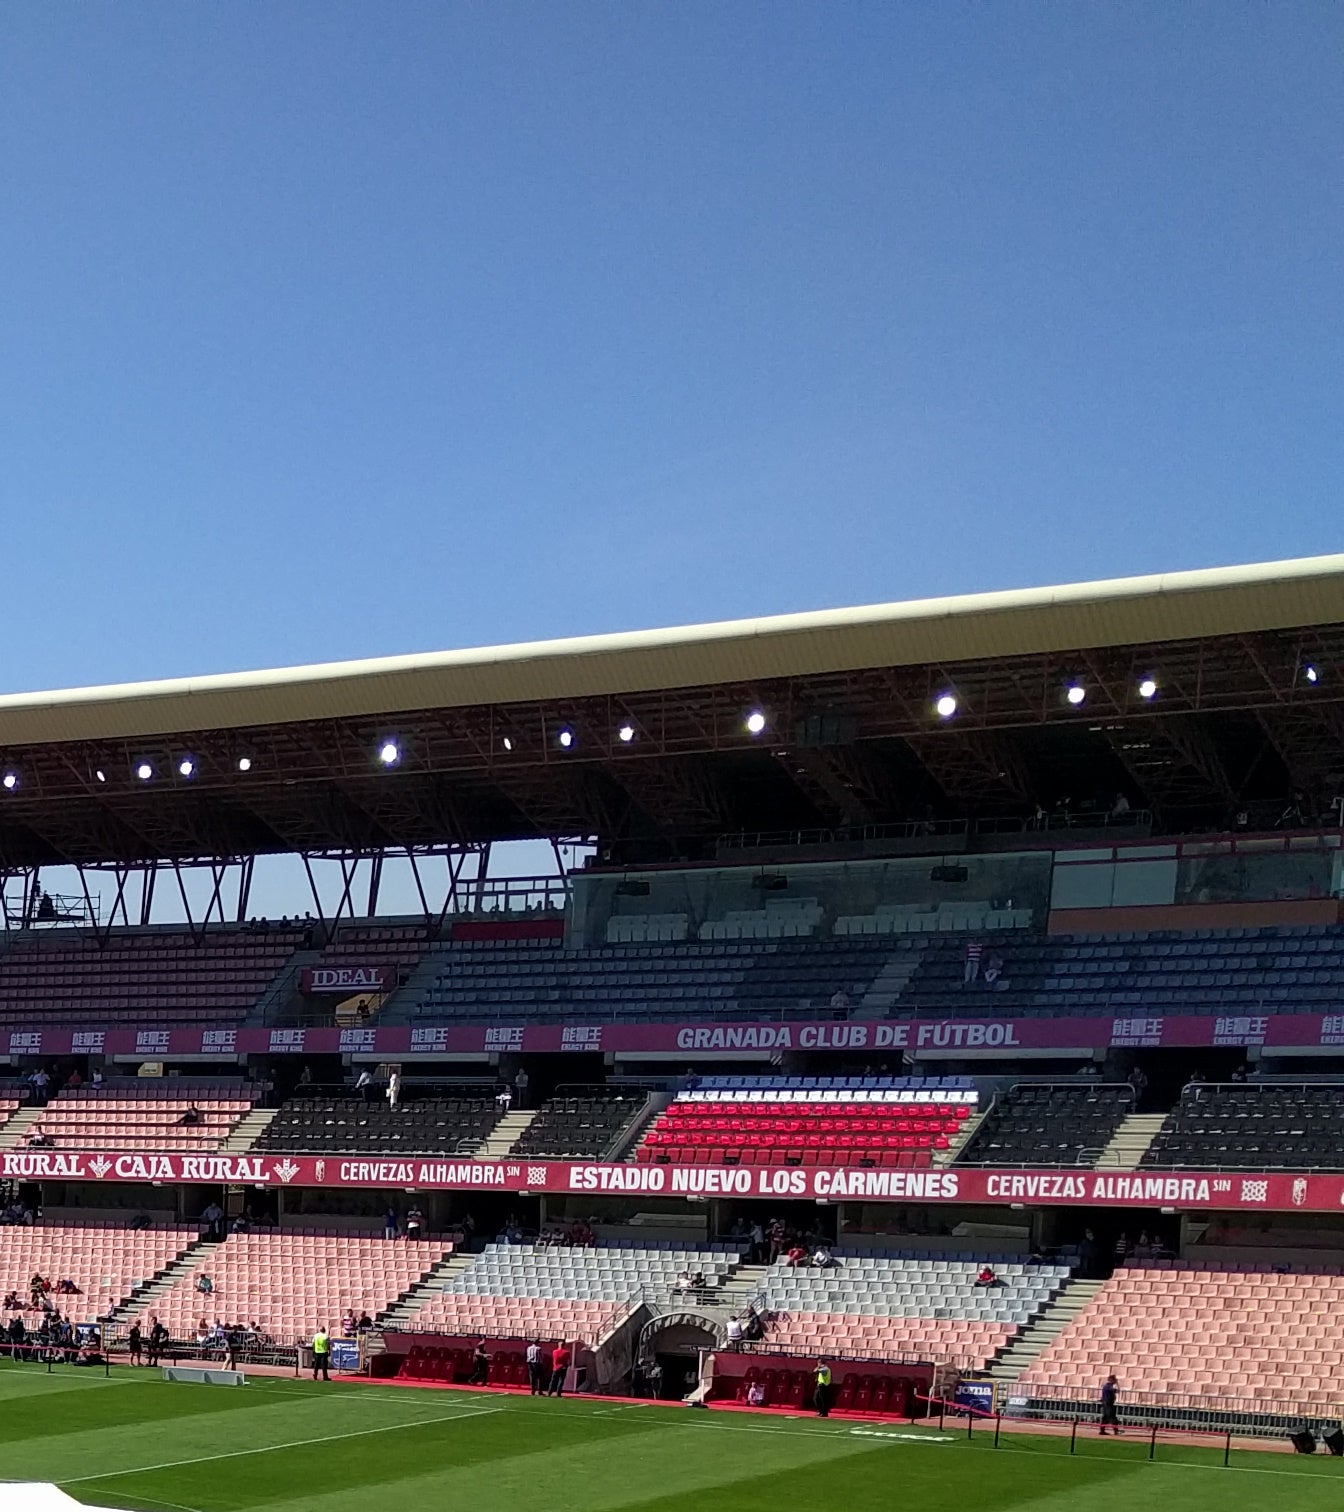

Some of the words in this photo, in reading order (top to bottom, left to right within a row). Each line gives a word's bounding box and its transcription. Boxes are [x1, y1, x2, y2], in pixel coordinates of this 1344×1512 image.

[312, 968, 383, 985] IDEAL
[677, 1026, 792, 1049] GRANADA
[800, 1026, 868, 1048] CLUB
[875, 1025, 910, 1046] DE
[917, 1021, 1020, 1046] FÚTBOL
[2, 1154, 85, 1177] RURAL
[115, 1155, 175, 1178] CAJA
[181, 1156, 270, 1180] RURAL
[340, 1162, 413, 1183] CERVEZAS
[419, 1164, 505, 1184] ALHAMBRA
[507, 1166, 520, 1177] SIN
[569, 1167, 665, 1191] ESTADIO
[672, 1168, 751, 1193] NUEVO
[759, 1170, 806, 1194] LOS
[814, 1168, 959, 1197] CÁRMENES
[987, 1174, 1086, 1199] CERVEZAS
[1093, 1176, 1210, 1201] ALHAMBRA
[1213, 1179, 1231, 1191] SIN
